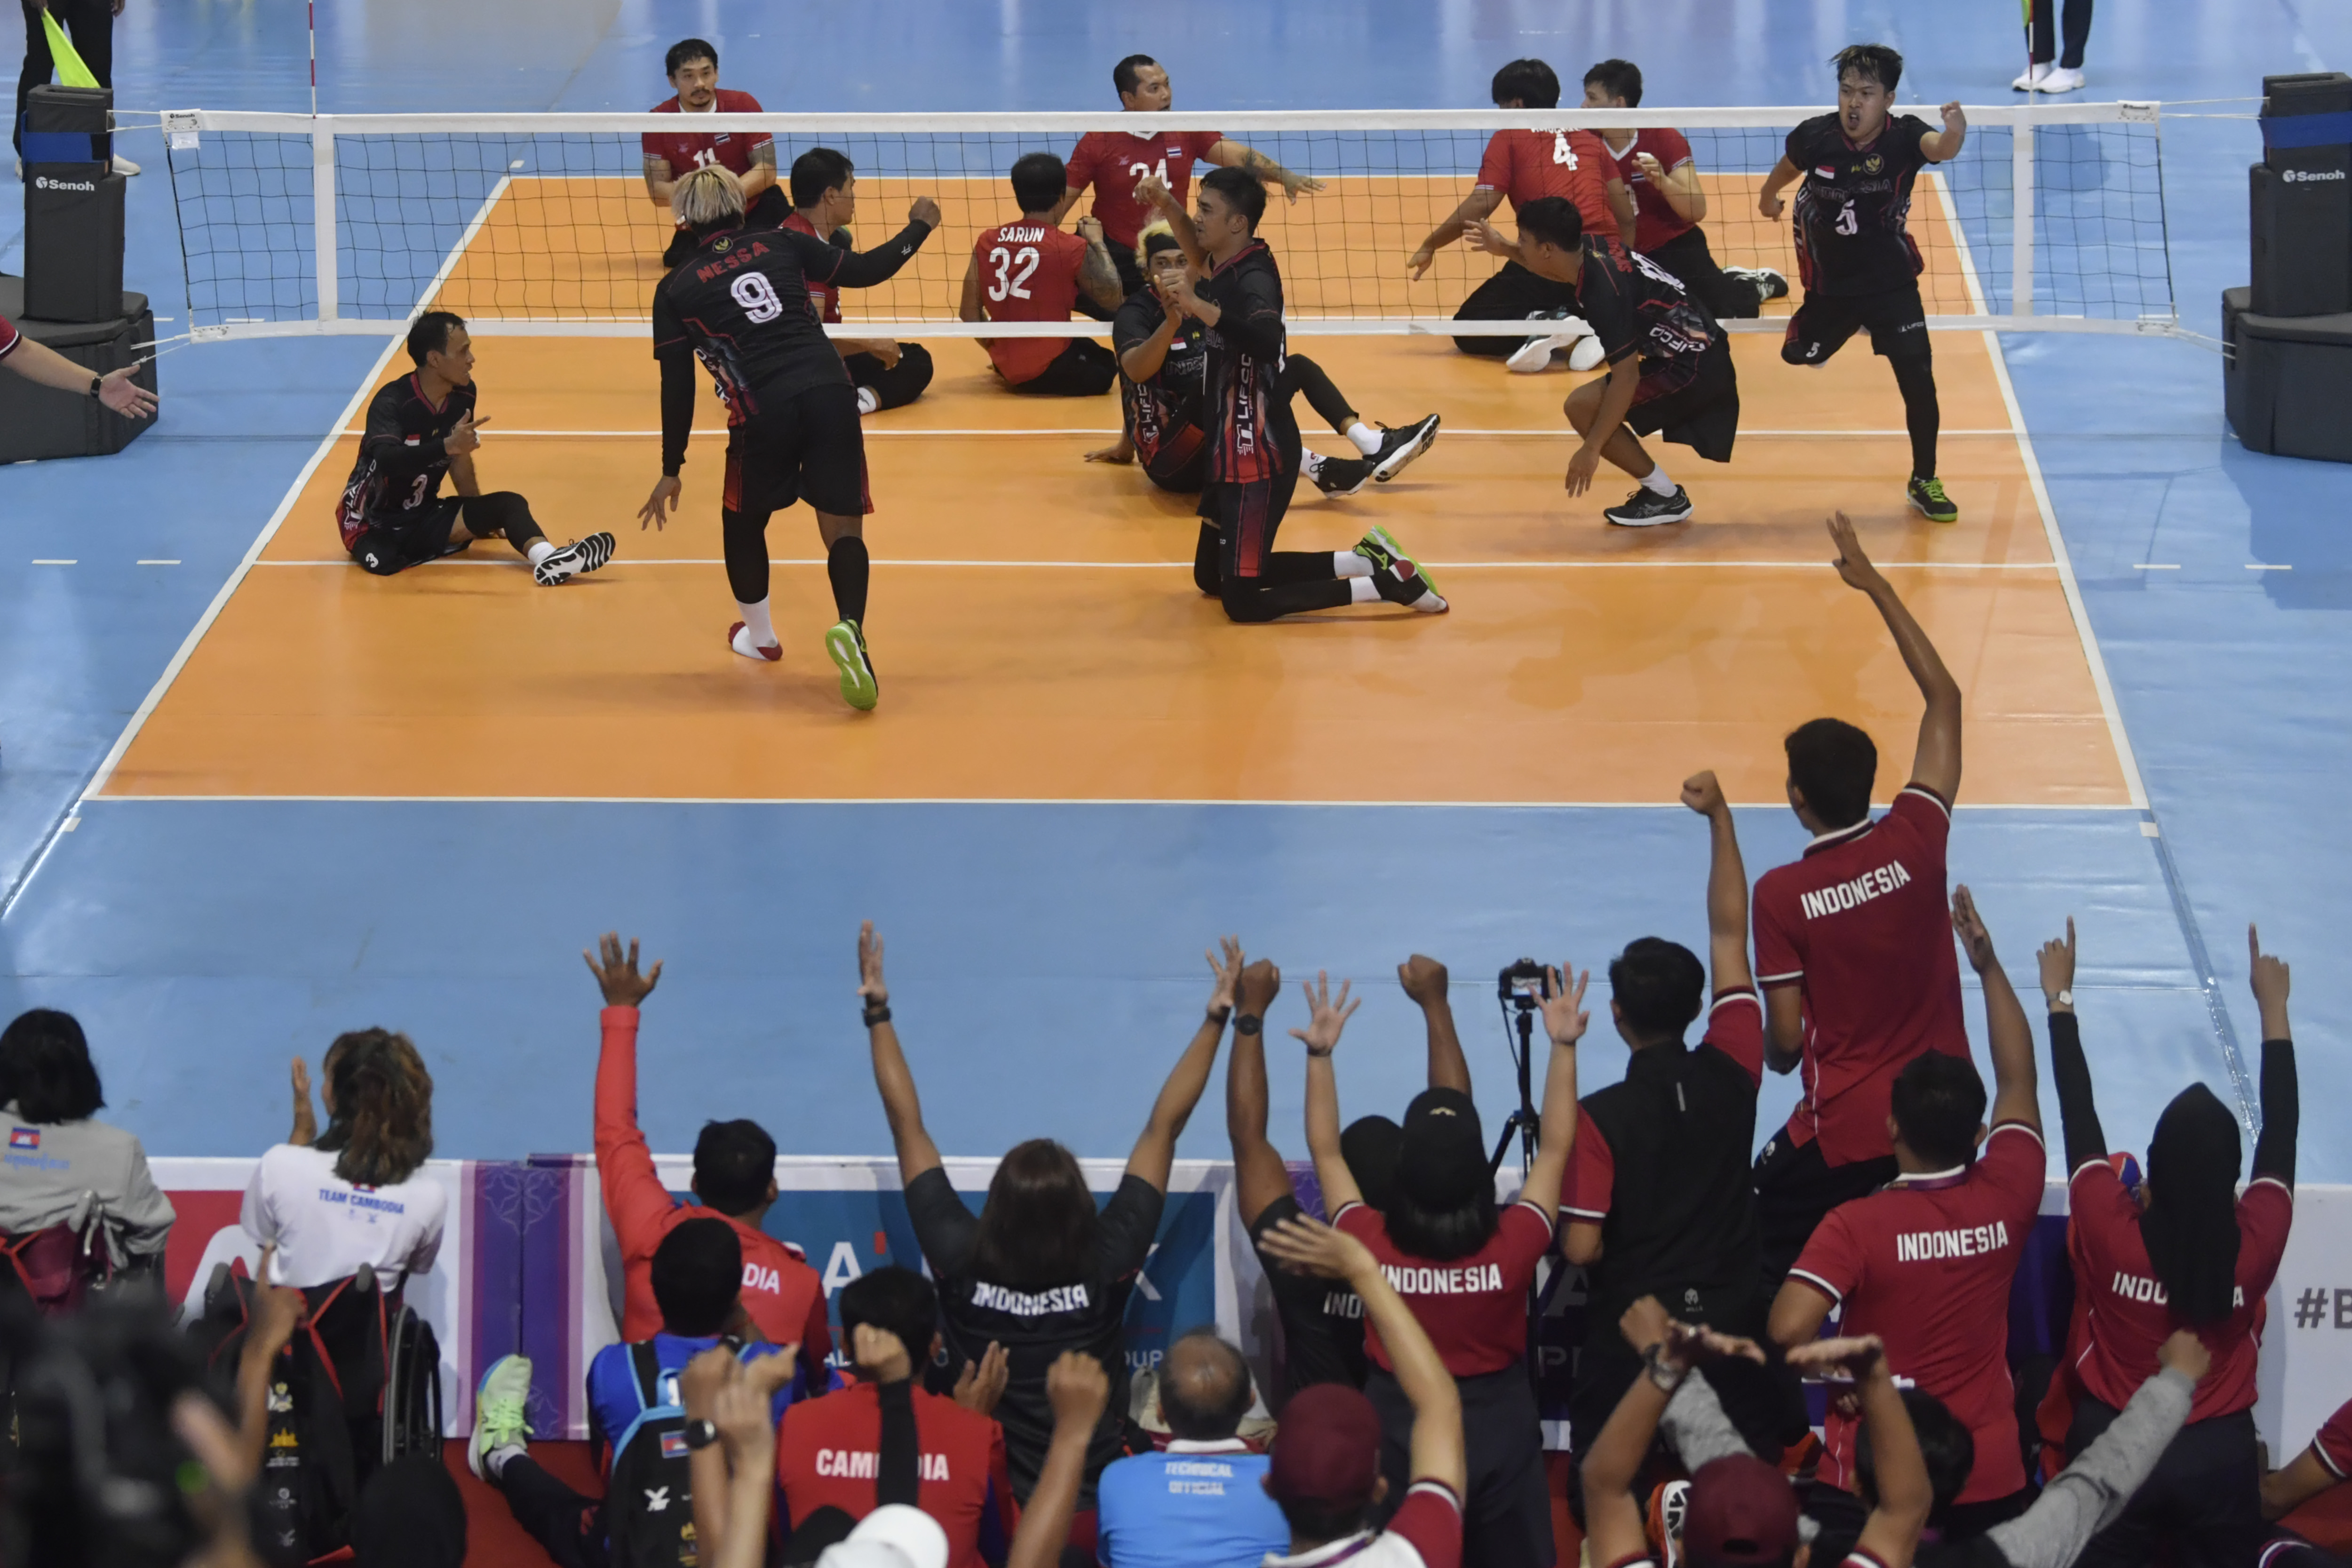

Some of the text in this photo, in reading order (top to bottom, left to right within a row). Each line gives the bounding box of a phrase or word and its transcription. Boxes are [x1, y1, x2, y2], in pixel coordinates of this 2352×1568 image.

[1553, 133, 1579, 171] 4
[48, 180, 95, 191] Senoh
[2296, 169, 2345, 182] Senoh
[997, 226, 1045, 242] SARUN
[1835, 199, 1858, 236] 5
[696, 241, 770, 283] NESSA
[988, 247, 1040, 302] 32
[731, 272, 783, 324] 9
[1805, 342, 1820, 358] 5
[402, 474, 428, 510] 3
[366, 552, 379, 568] 3
[1801, 860, 1911, 920] INDONESIA
[319, 1188, 405, 1215] TEAM CAMBODIA
[1897, 1220, 2009, 1262] INDONESIA
[971, 1281, 1090, 1316] INDONESIA
[2112, 1271, 2244, 1307] INDOA
[815, 1448, 950, 1481] CAMIA
